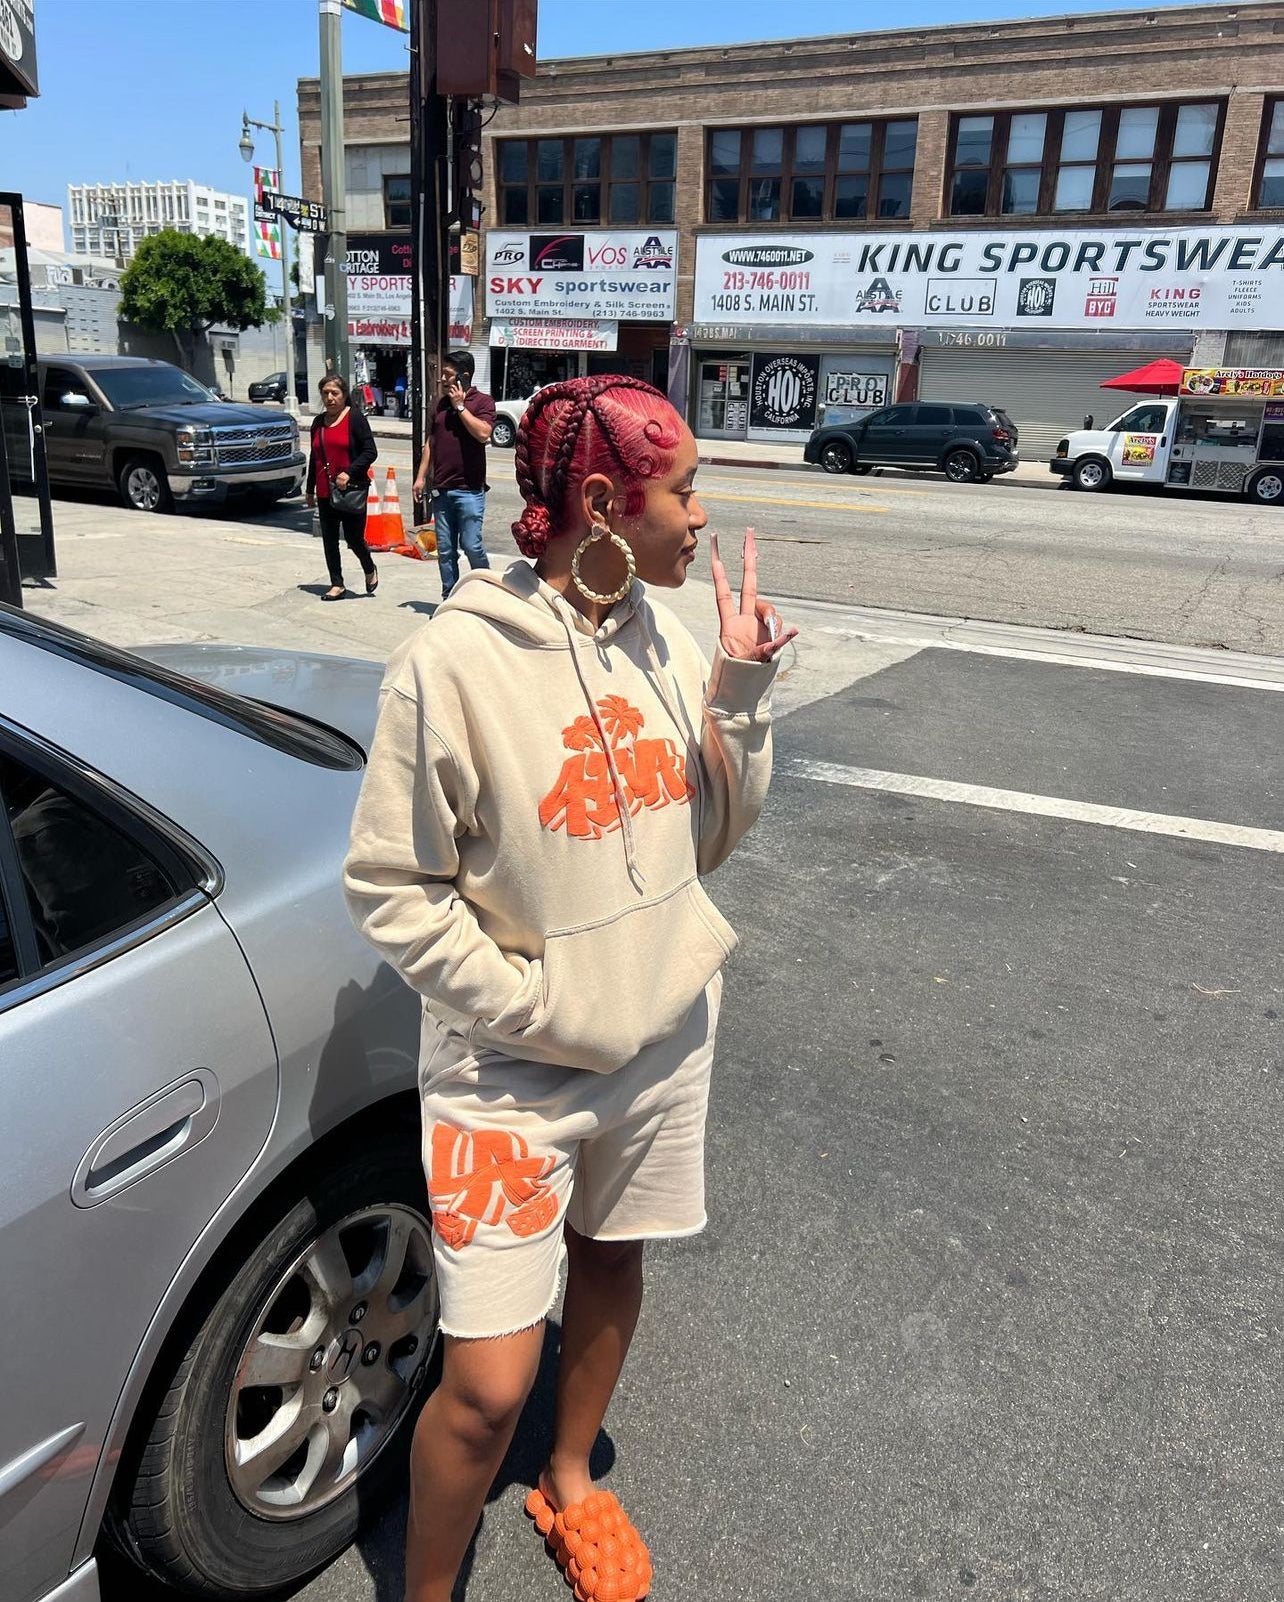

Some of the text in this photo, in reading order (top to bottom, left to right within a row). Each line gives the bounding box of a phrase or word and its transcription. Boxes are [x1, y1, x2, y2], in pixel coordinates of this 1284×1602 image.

[729, 250, 807, 262] WWW.7460011.NET
[857, 243, 964, 273] KING
[490, 277, 671, 295] SKY sportswear
[723, 271, 810, 290] 213-746-0011
[1150, 288, 1201, 299] KING
[495, 299, 531, 307] Custom
[534, 299, 591, 309] Embroidery
[594, 300, 601, 308] &
[605, 301, 624, 309] Silk
[712, 294, 819, 312] 1408 S. MAIN ST.
[928, 295, 991, 312] CLUB
[1148, 301, 1200, 309] SPORTSWEAR
[528, 308, 550, 316] Main
[592, 310, 617, 318] (213)
[513, 327, 543, 337] SCREEN
[545, 328, 585, 338] PRINTING
[550, 338, 560, 347] TO
[755, 371, 767, 406] HOUSTON
[764, 357, 798, 373] OVERSEAS
[1245, 370, 1282, 379] Hotdogs
[837, 376, 877, 391] PRO
[829, 388, 884, 404] CLUB
[764, 410, 800, 425] CALIFORNIA
